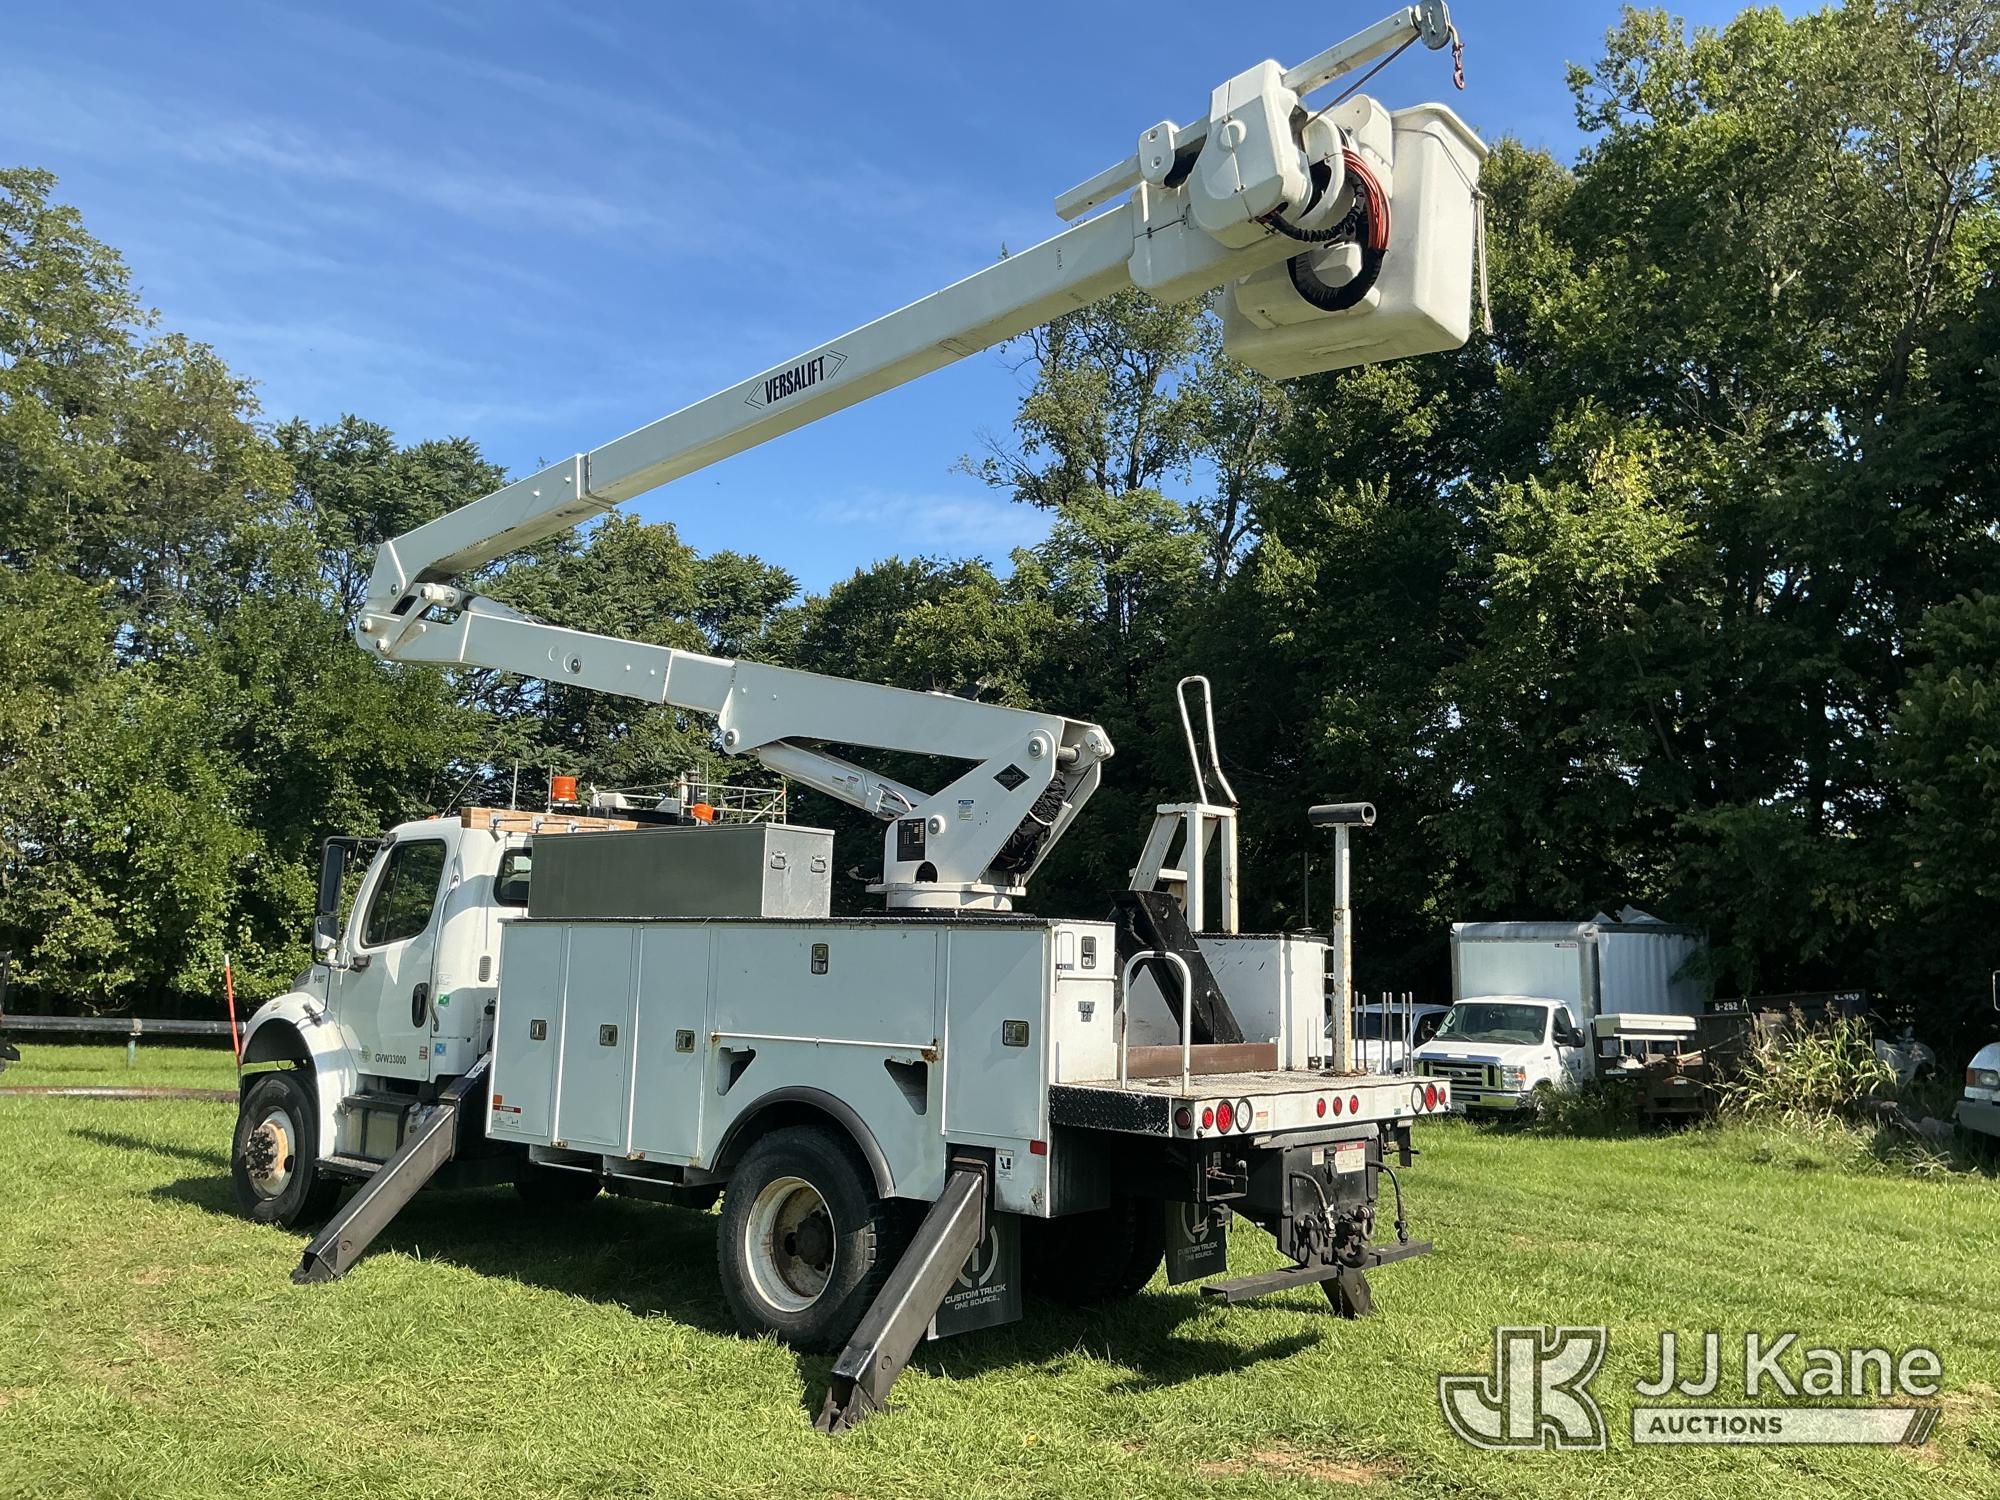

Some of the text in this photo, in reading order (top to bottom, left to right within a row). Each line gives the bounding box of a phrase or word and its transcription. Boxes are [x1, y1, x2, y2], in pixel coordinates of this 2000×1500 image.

[764, 355, 825, 405] VERSALIFT
[375, 1053, 407, 1065] GVW33000
[944, 1283, 1007, 1304] CUSTOM TRUCK
[954, 1301, 969, 1310] ONE
